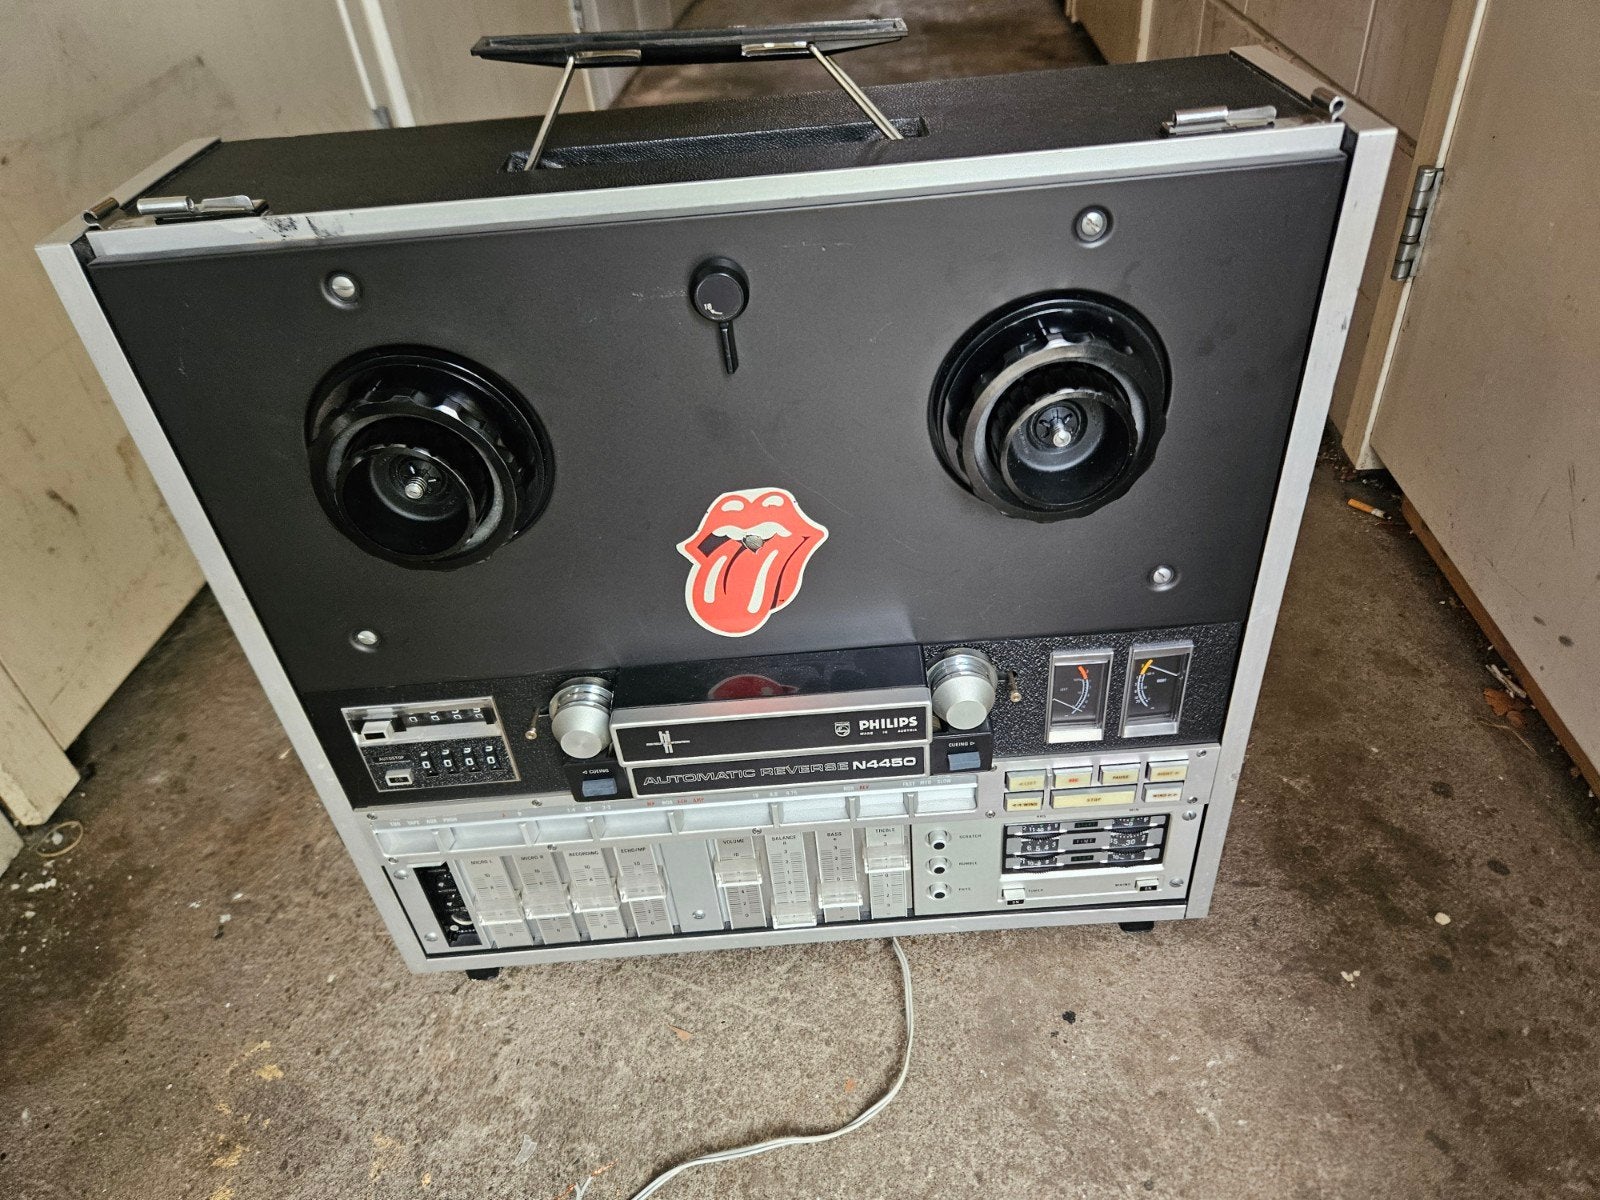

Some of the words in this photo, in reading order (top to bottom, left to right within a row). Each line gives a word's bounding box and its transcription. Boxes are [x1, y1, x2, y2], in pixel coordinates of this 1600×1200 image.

[859, 716, 918, 730] PHILIPS
[643, 768, 756, 786] AUTOMATIC
[760, 762, 849, 776] REVERSE
[853, 756, 917, 771] N4450
